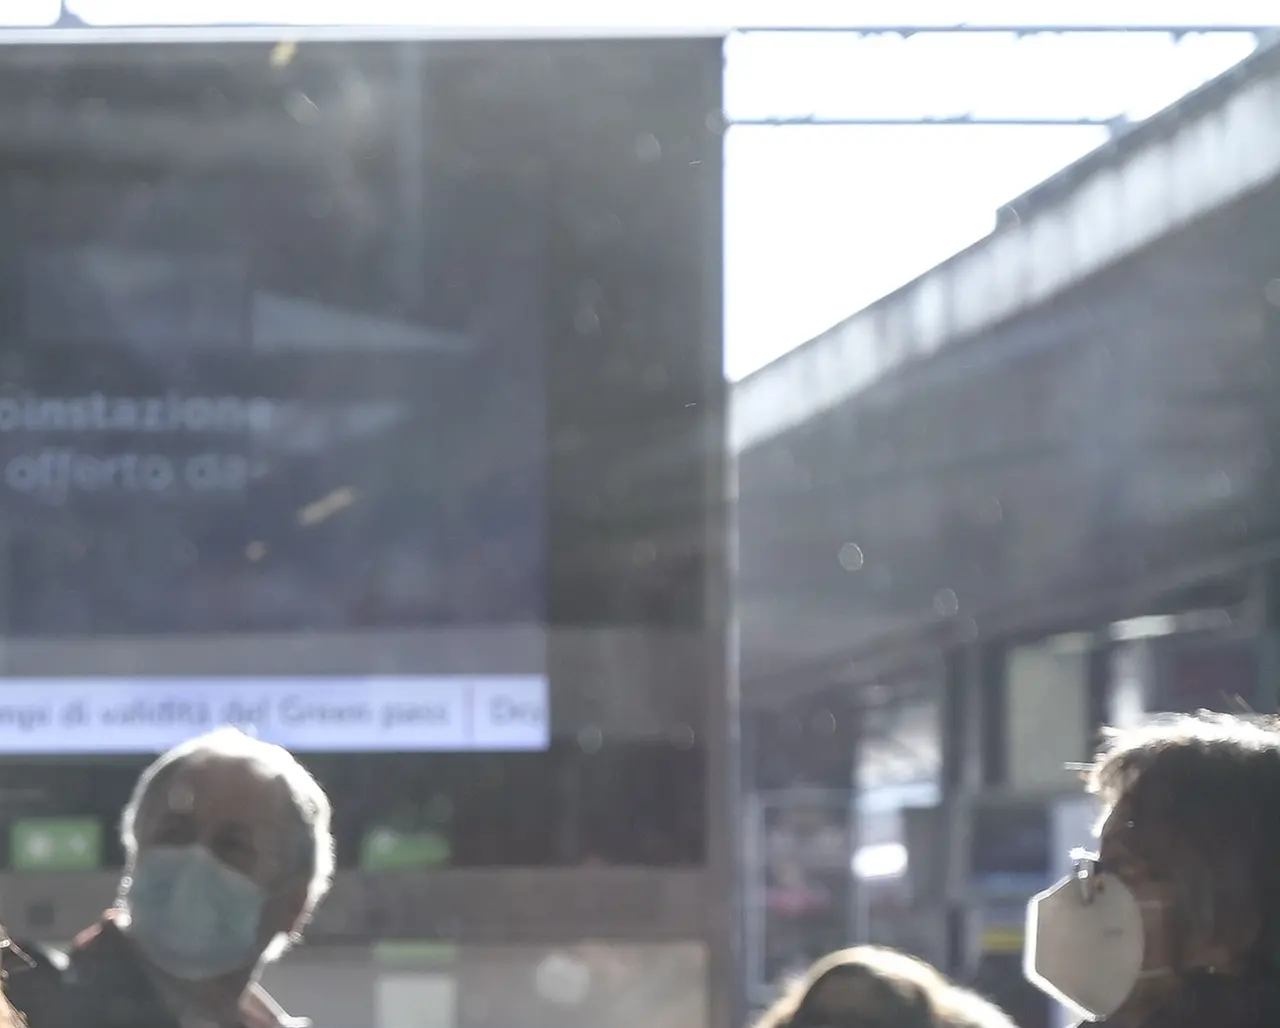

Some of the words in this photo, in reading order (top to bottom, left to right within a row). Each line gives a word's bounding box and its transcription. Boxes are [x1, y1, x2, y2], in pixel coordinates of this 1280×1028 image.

[5, 447, 175, 504] offerto
[61, 697, 90, 728] di
[278, 696, 372, 727] Green
[377, 702, 451, 733] pass
